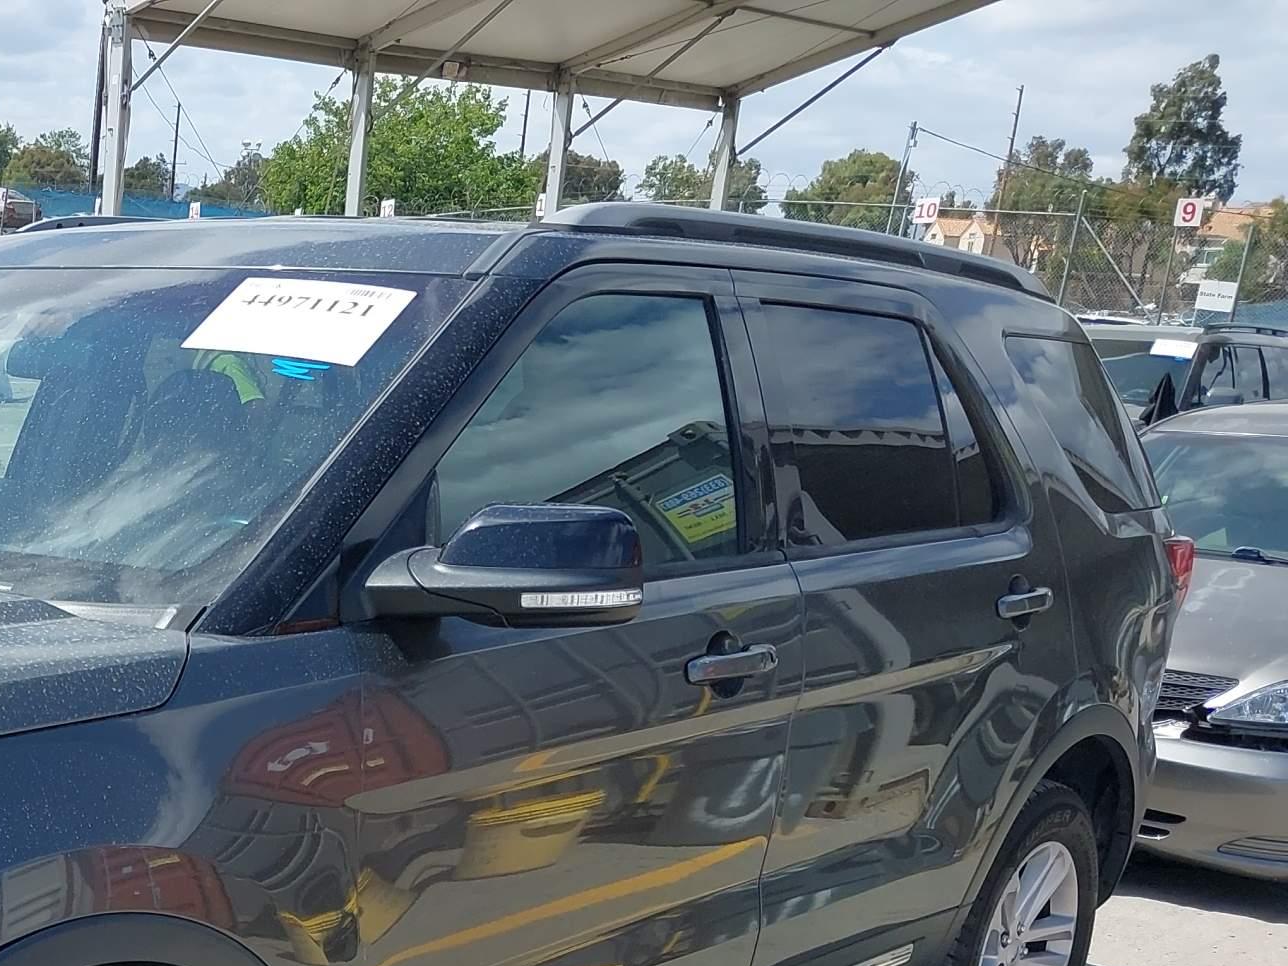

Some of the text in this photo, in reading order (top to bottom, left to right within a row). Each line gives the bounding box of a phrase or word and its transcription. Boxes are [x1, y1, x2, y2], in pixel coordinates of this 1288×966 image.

[915, 202, 937, 218] 10
[1182, 202, 1197, 223] 9
[241, 293, 375, 318] 44971121
